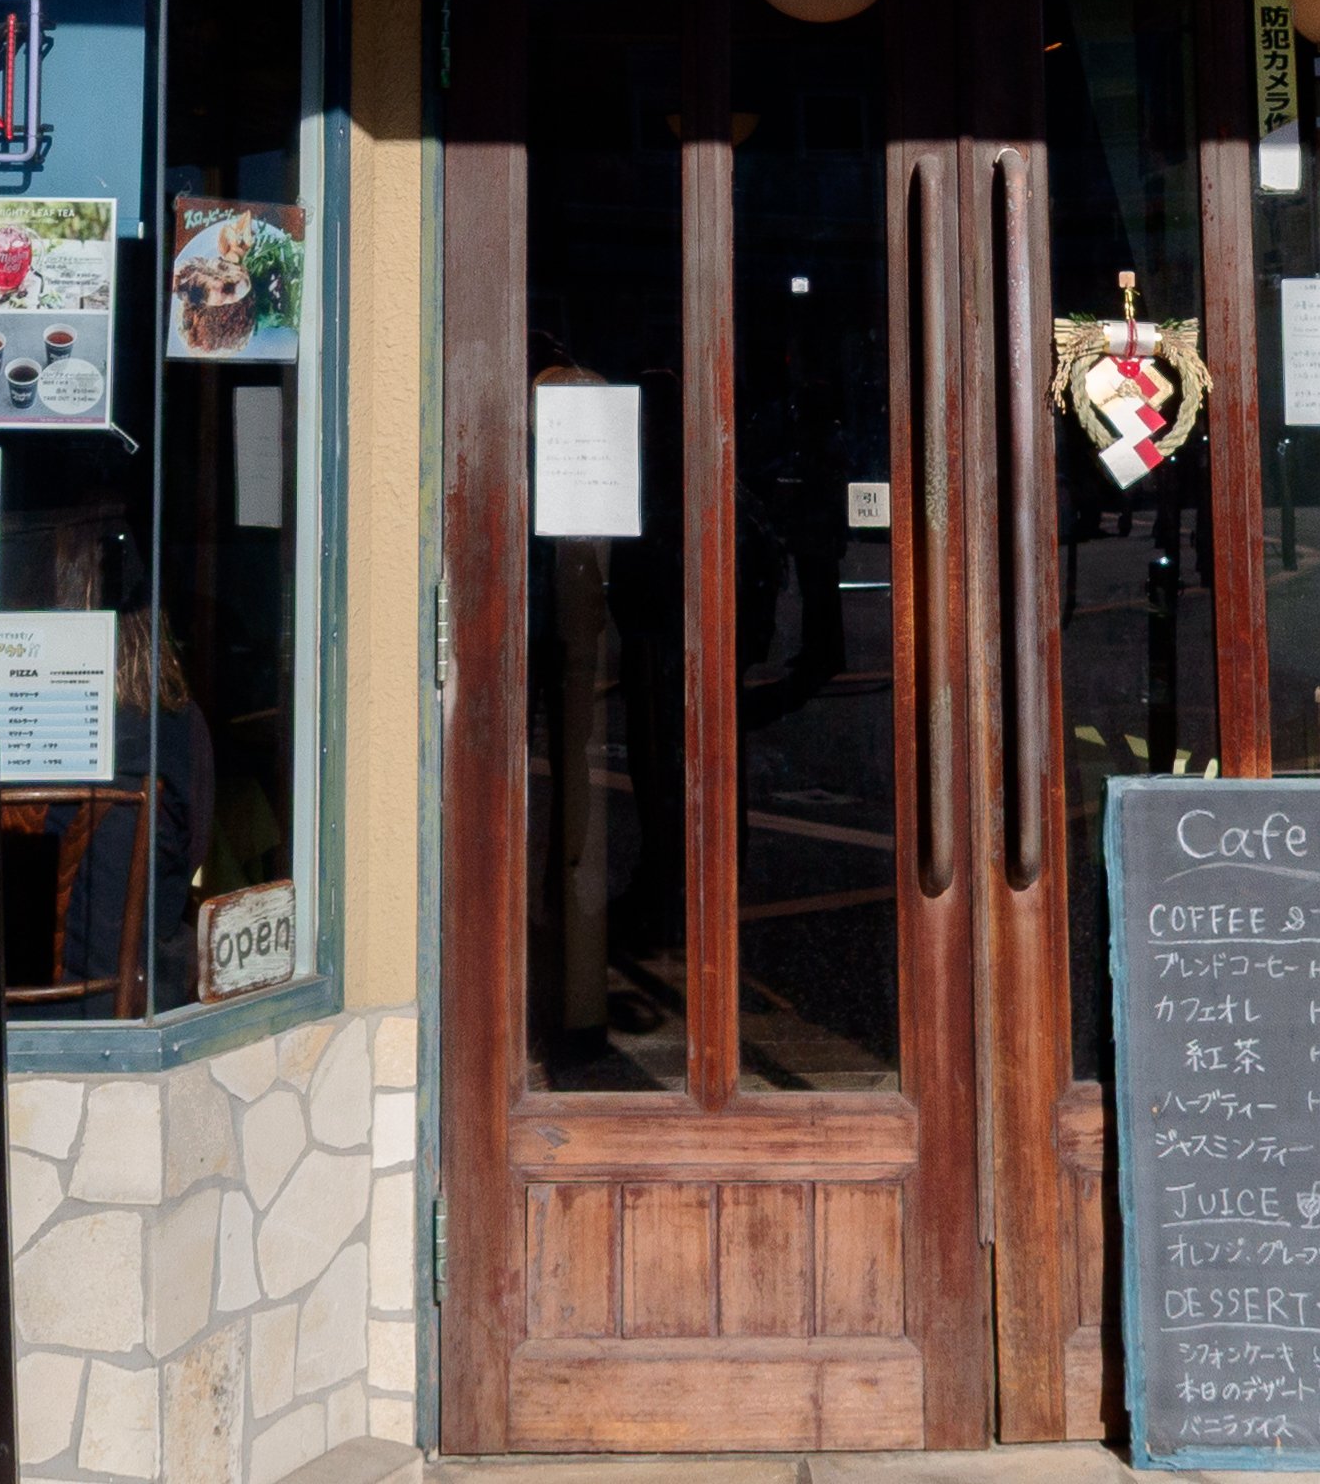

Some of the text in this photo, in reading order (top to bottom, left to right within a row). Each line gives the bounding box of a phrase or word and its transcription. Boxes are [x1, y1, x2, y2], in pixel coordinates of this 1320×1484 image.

[31, 208, 55, 217] LEAF
[57, 209, 76, 218] TEA
[9, 668, 39, 678] PIZZA
[1177, 808, 1308, 860] Cafe
[1148, 903, 1267, 936] COFFEE
[215, 915, 291, 970] open
[1153, 954, 1299, 980] ブレンドコーヒー
[1154, 993, 1262, 1025] カフェオレ
[1184, 1038, 1267, 1075] 紅茶
[1160, 1089, 1278, 1122] ハーブティー
[1154, 1129, 1314, 1167] ジャスミンティー
[1165, 1182, 1281, 1219] JUICE
[1165, 1286, 1310, 1327] DESSERT
[1178, 1341, 1295, 1374] シフォンケーキ
[1176, 1377, 1317, 1404] 本日のデザート
[1180, 1415, 1295, 1440] バニラアイス
